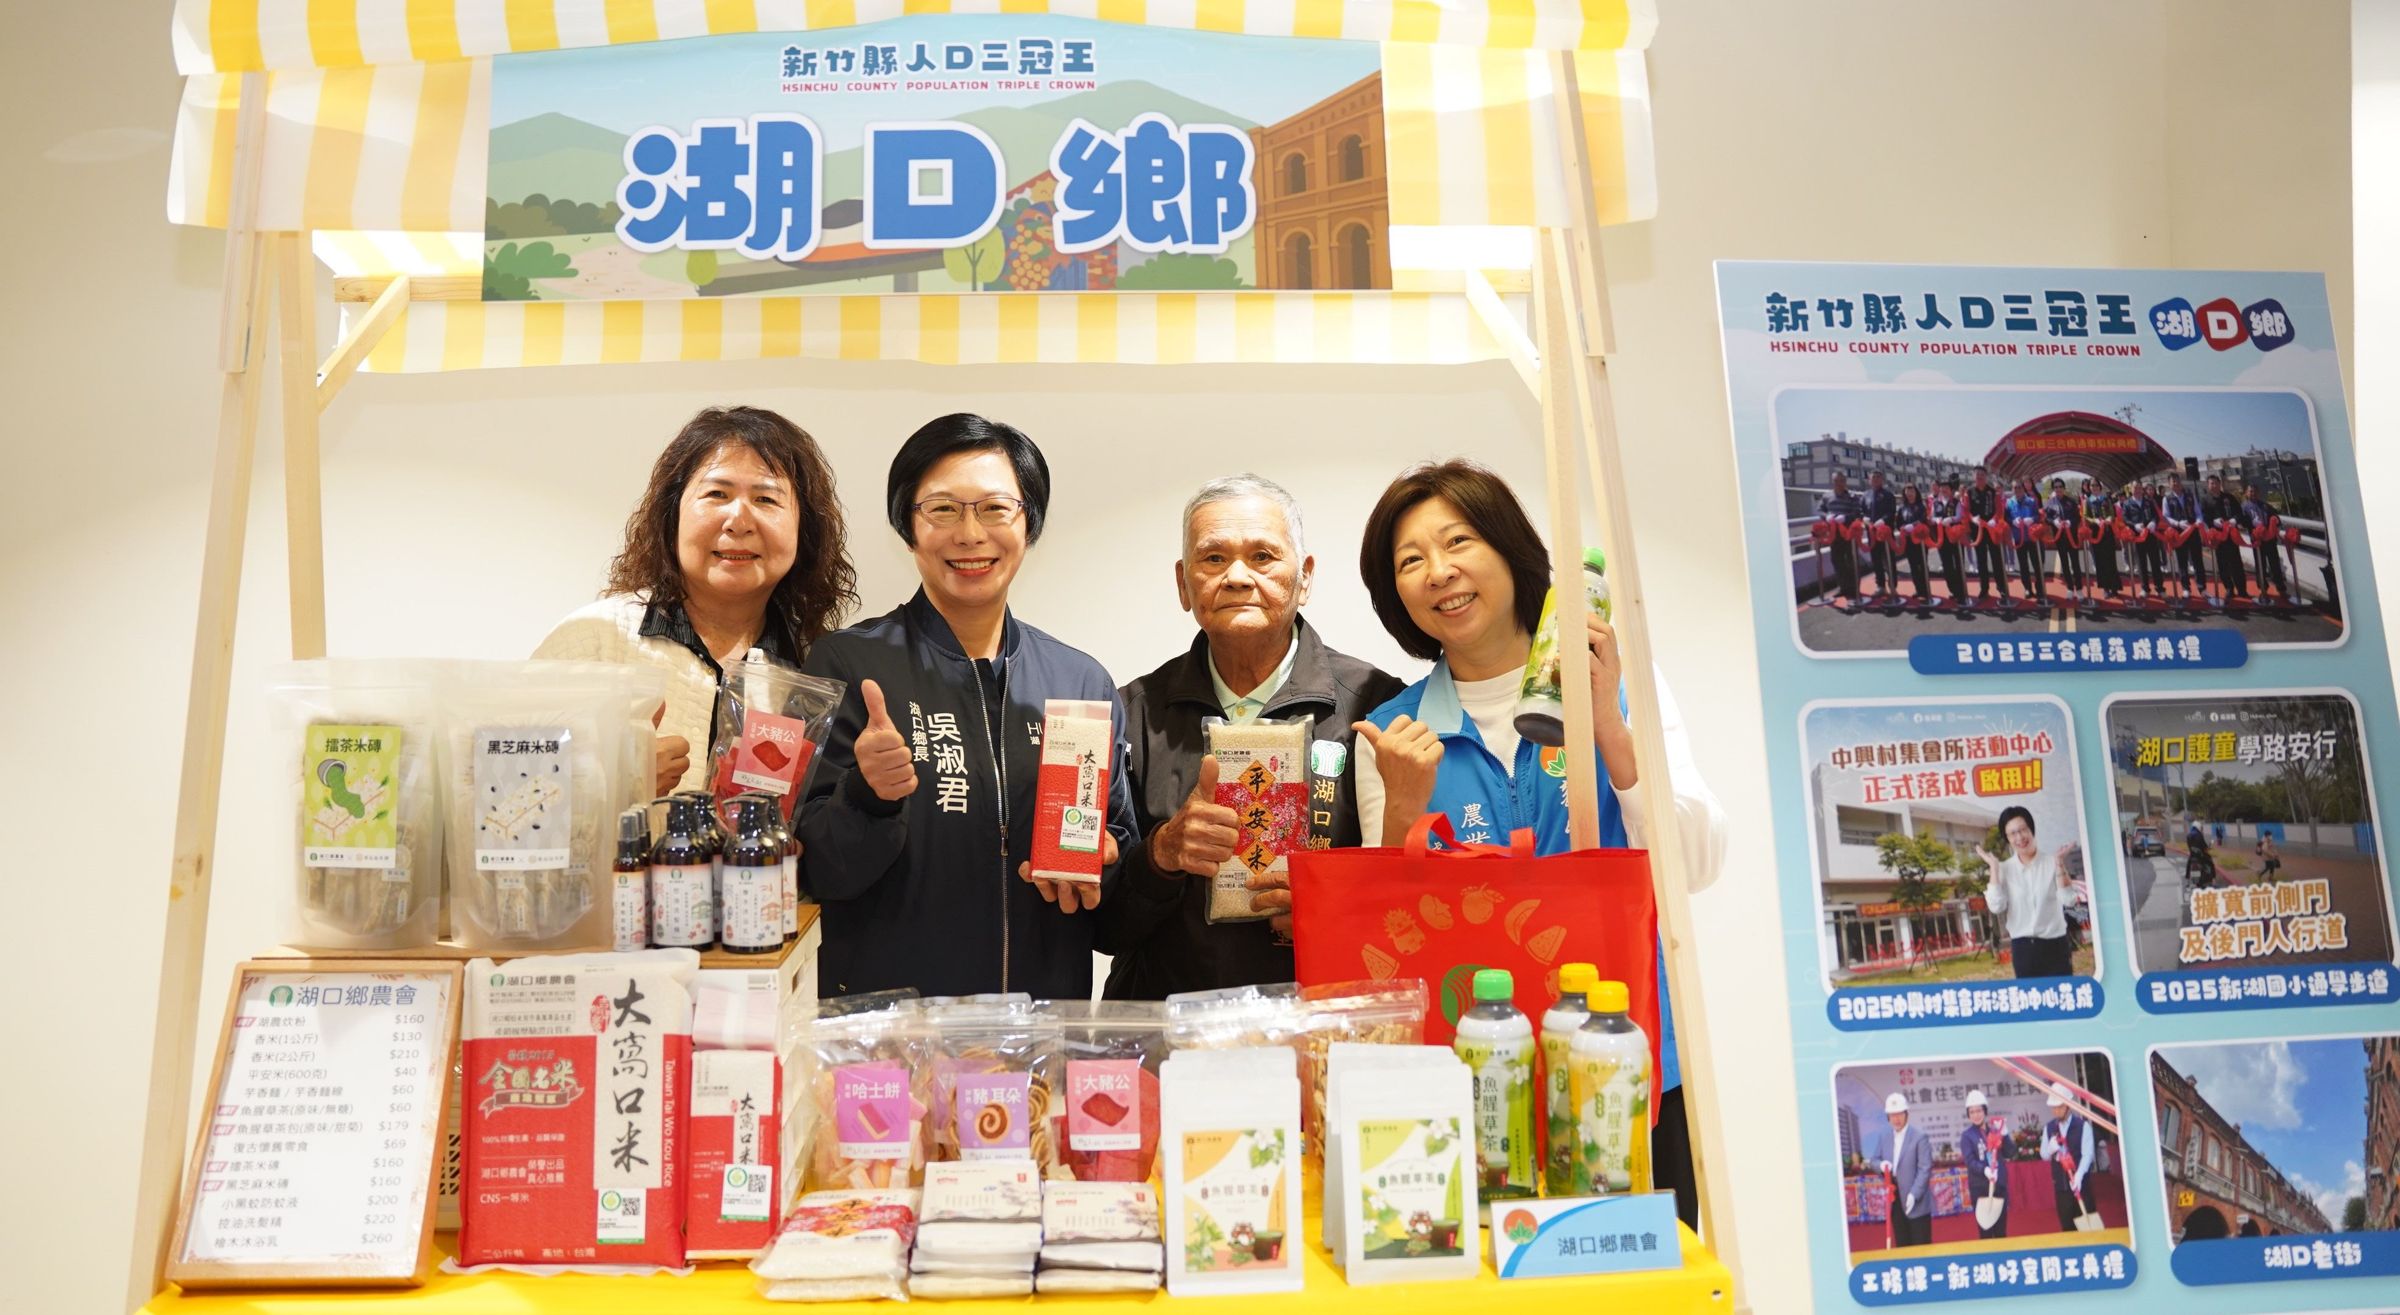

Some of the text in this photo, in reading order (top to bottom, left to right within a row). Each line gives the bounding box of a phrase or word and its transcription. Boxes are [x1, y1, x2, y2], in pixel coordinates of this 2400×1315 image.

[782, 39, 1095, 78] 新竹縣人口三冠王
[782, 80, 1095, 92] HSINCHU COUNTY POPULATION TRIPLE CROWN
[625, 117, 1247, 254] 湖口鄉
[1766, 291, 2287, 339] 新竹縣人口三冠王 湖口鄉
[1770, 341, 2140, 356] HSINCHU COUNTY POPULATION TRIPLE CROWN
[1957, 635, 2201, 663] 2025三合橋落成典禮
[756, 723, 796, 744] 大豬公
[909, 701, 930, 763] 湖口鄉長
[325, 738, 382, 753] 擂茶米磚
[487, 739, 560, 755] 黑芝麻米磚
[1832, 731, 2054, 769] 中興村集會所活動中心
[2136, 730, 2337, 767] 湖口護童學路安行
[927, 712, 970, 814] 吳淑君
[1081, 749, 1097, 808] 大窩口米
[1863, 770, 1968, 803] 正式落成
[1244, 766, 1269, 871] 平安米
[2192, 881, 2329, 922] 擴寬前側門
[2181, 915, 2347, 961] 及後門人行道
[297, 984, 417, 1007] 湖口鄉農會
[2150, 969, 2389, 1003] 2025新湖國小通學步道
[1838, 981, 2093, 1021] 2025中興村集會所活動中心落成
[395, 1014, 425, 1024] $160
[255, 1032, 422, 1045] 香米(1公斤) $130
[251, 1049, 420, 1063] 香米(2公斤) $210
[248, 1067, 417, 1081] 平安米(600克) $40
[610, 978, 652, 1174] 大窩口米
[1082, 1074, 1131, 1092] 大豬公
[392, 1085, 414, 1095] $60
[851, 1081, 901, 1100] 哈士餅
[972, 1087, 1022, 1105] 豬耳朵
[389, 1102, 412, 1113] $60
[1482, 1075, 1499, 1152] 魚腥草茶
[378, 1120, 409, 1131] $179
[663, 1060, 676, 1188] Taiwan Tai Wo Kou Rice
[739, 1092, 755, 1165] 大窩口米
[384, 1139, 407, 1149] $69
[373, 1158, 404, 1168] $160
[370, 1176, 401, 1187] $160
[367, 1195, 399, 1206] $200
[364, 1214, 396, 1225] $220
[361, 1233, 393, 1244] $260
[1558, 1231, 1658, 1257] 湖口鄉農會
[2264, 1240, 2362, 1270] 湖口老街
